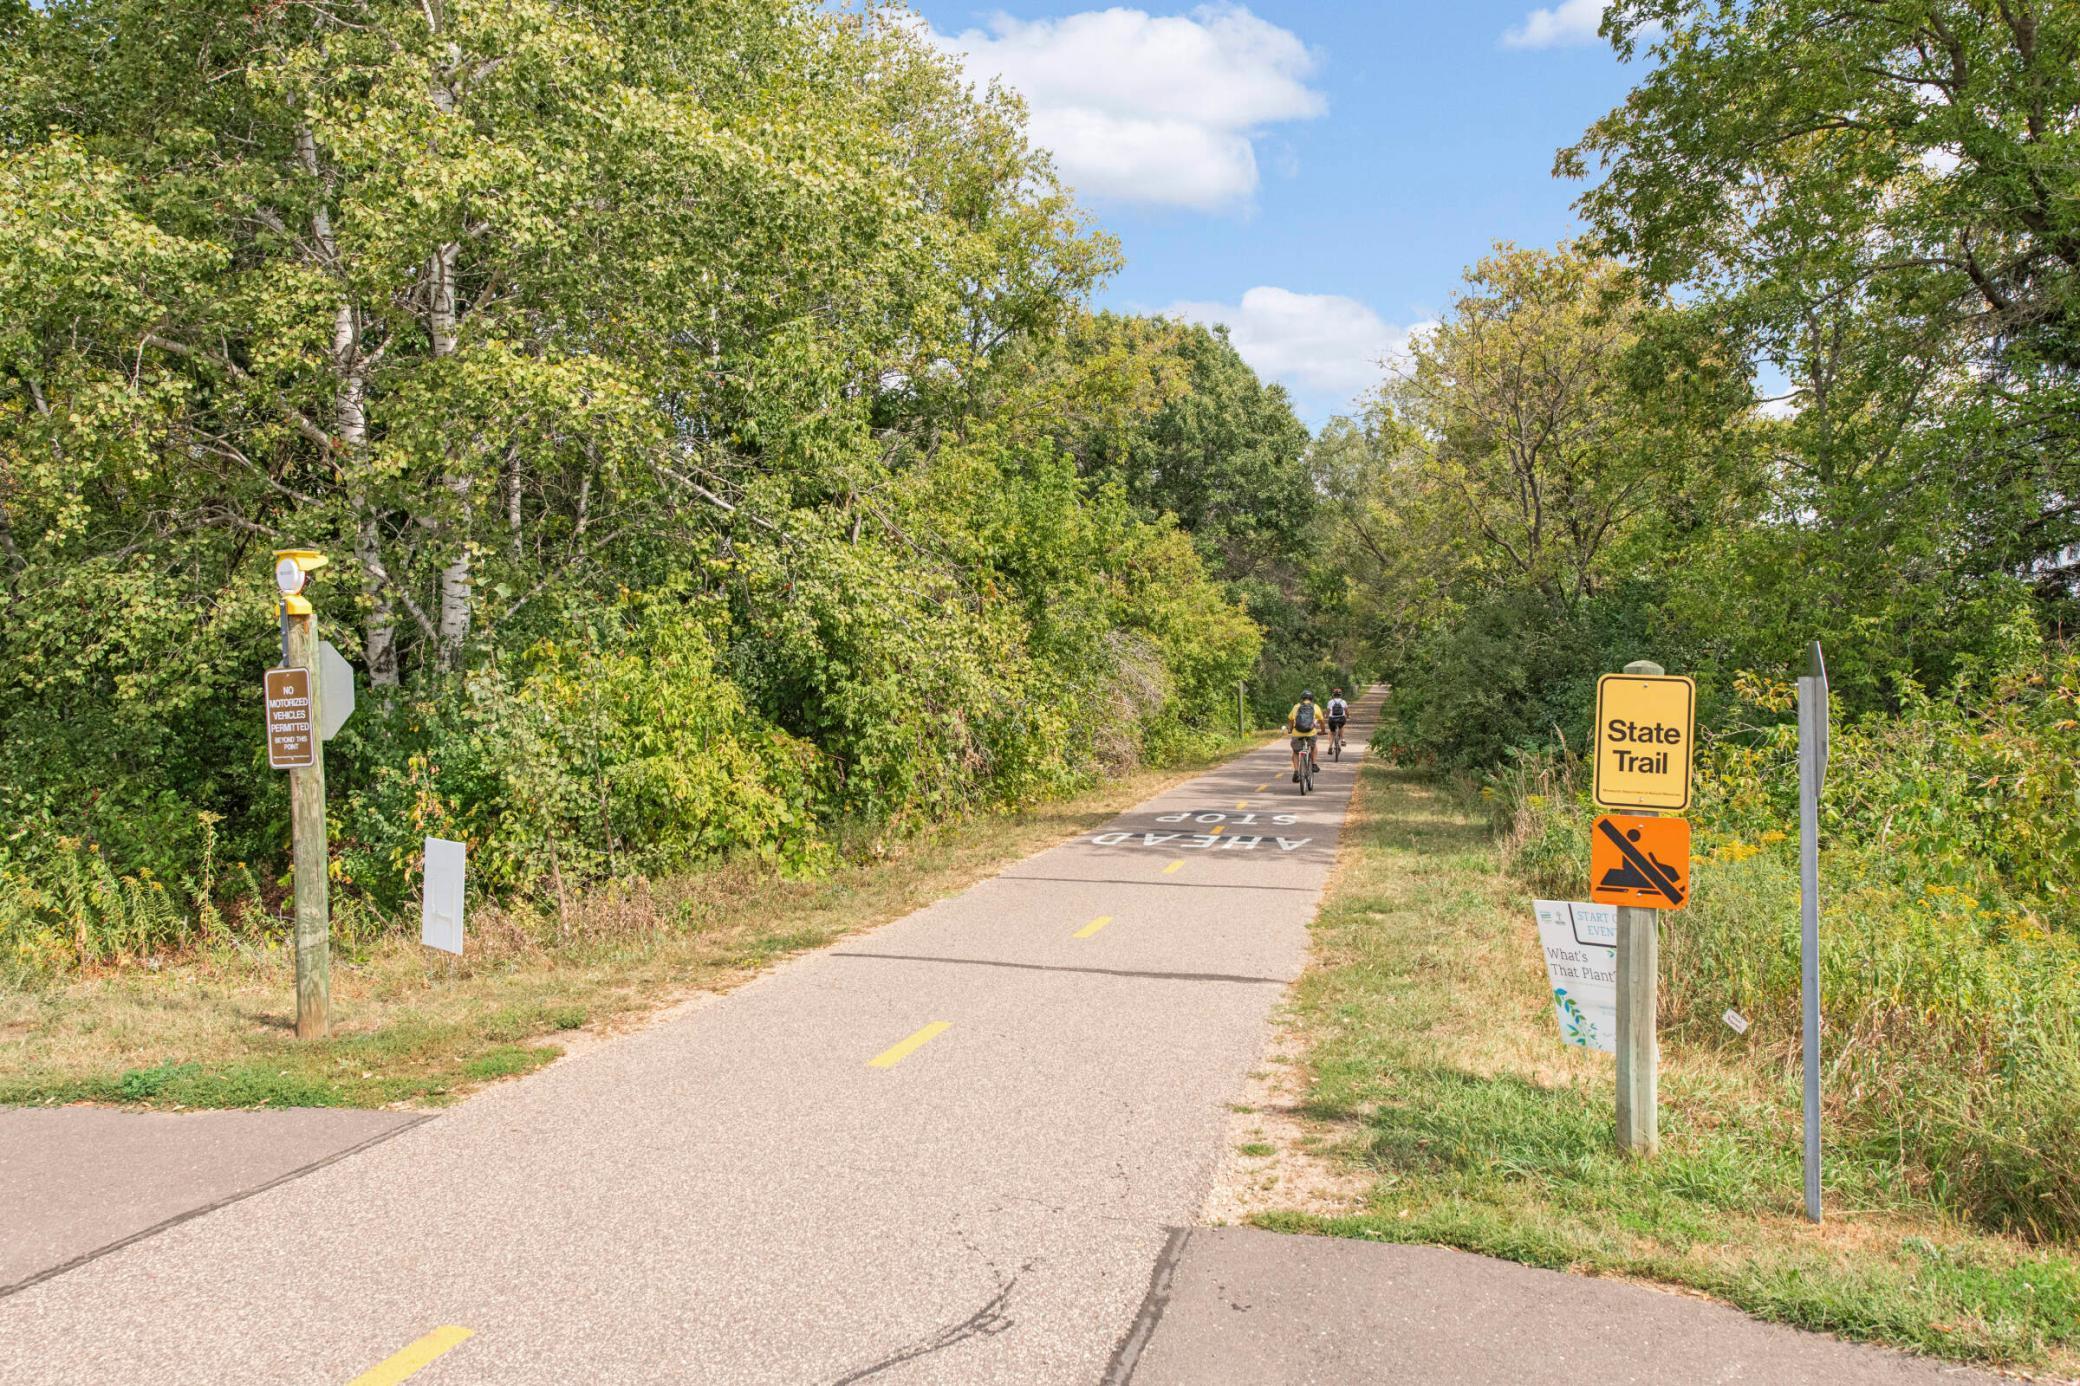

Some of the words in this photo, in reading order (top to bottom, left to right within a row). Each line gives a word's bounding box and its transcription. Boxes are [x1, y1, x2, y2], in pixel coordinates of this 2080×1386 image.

[283, 686, 294, 695] NO
[270, 698, 309, 707] MOTORIZED
[273, 711, 305, 720] VEHICLES
[271, 722, 310, 732] PERMITTED
[1607, 719, 1681, 745] State
[1612, 749, 1668, 775] Trail
[1156, 812, 1299, 825] STOP
[1091, 832, 1312, 851] AHEAD
[1576, 910, 1609, 924] START
[1546, 946, 1589, 962] What's
[1550, 963, 1580, 978] That
